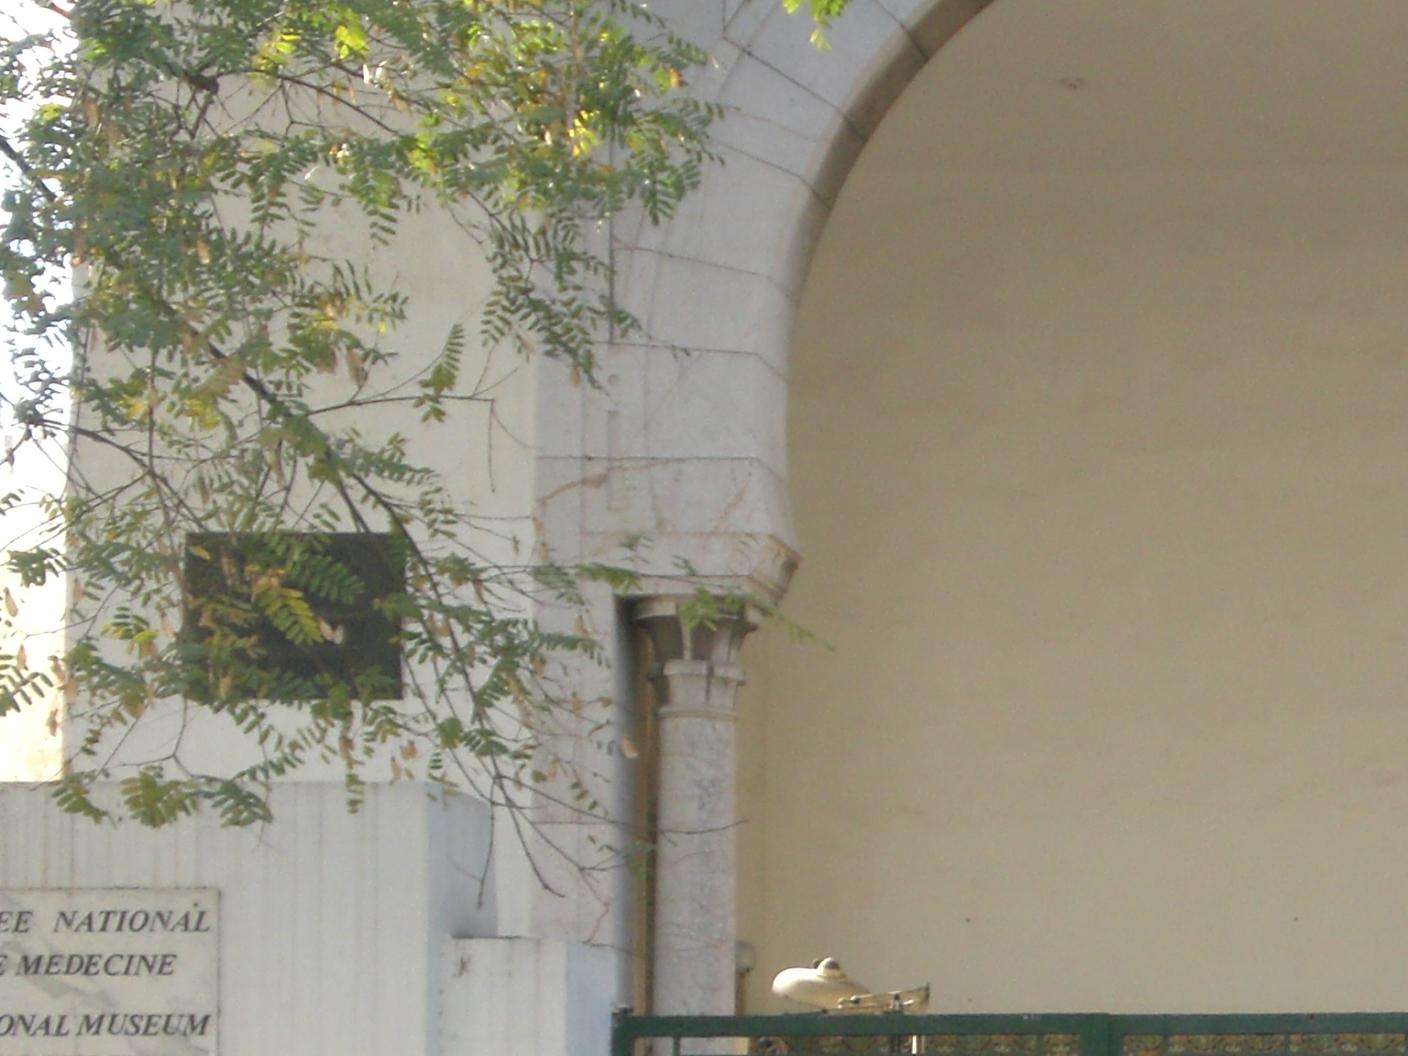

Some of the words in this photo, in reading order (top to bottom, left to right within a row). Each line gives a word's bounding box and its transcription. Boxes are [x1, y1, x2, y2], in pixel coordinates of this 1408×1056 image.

[53, 909, 211, 934] NATIONAL
[15, 953, 178, 977] MEDECINE
[75, 1012, 212, 1037] MUSEUM
